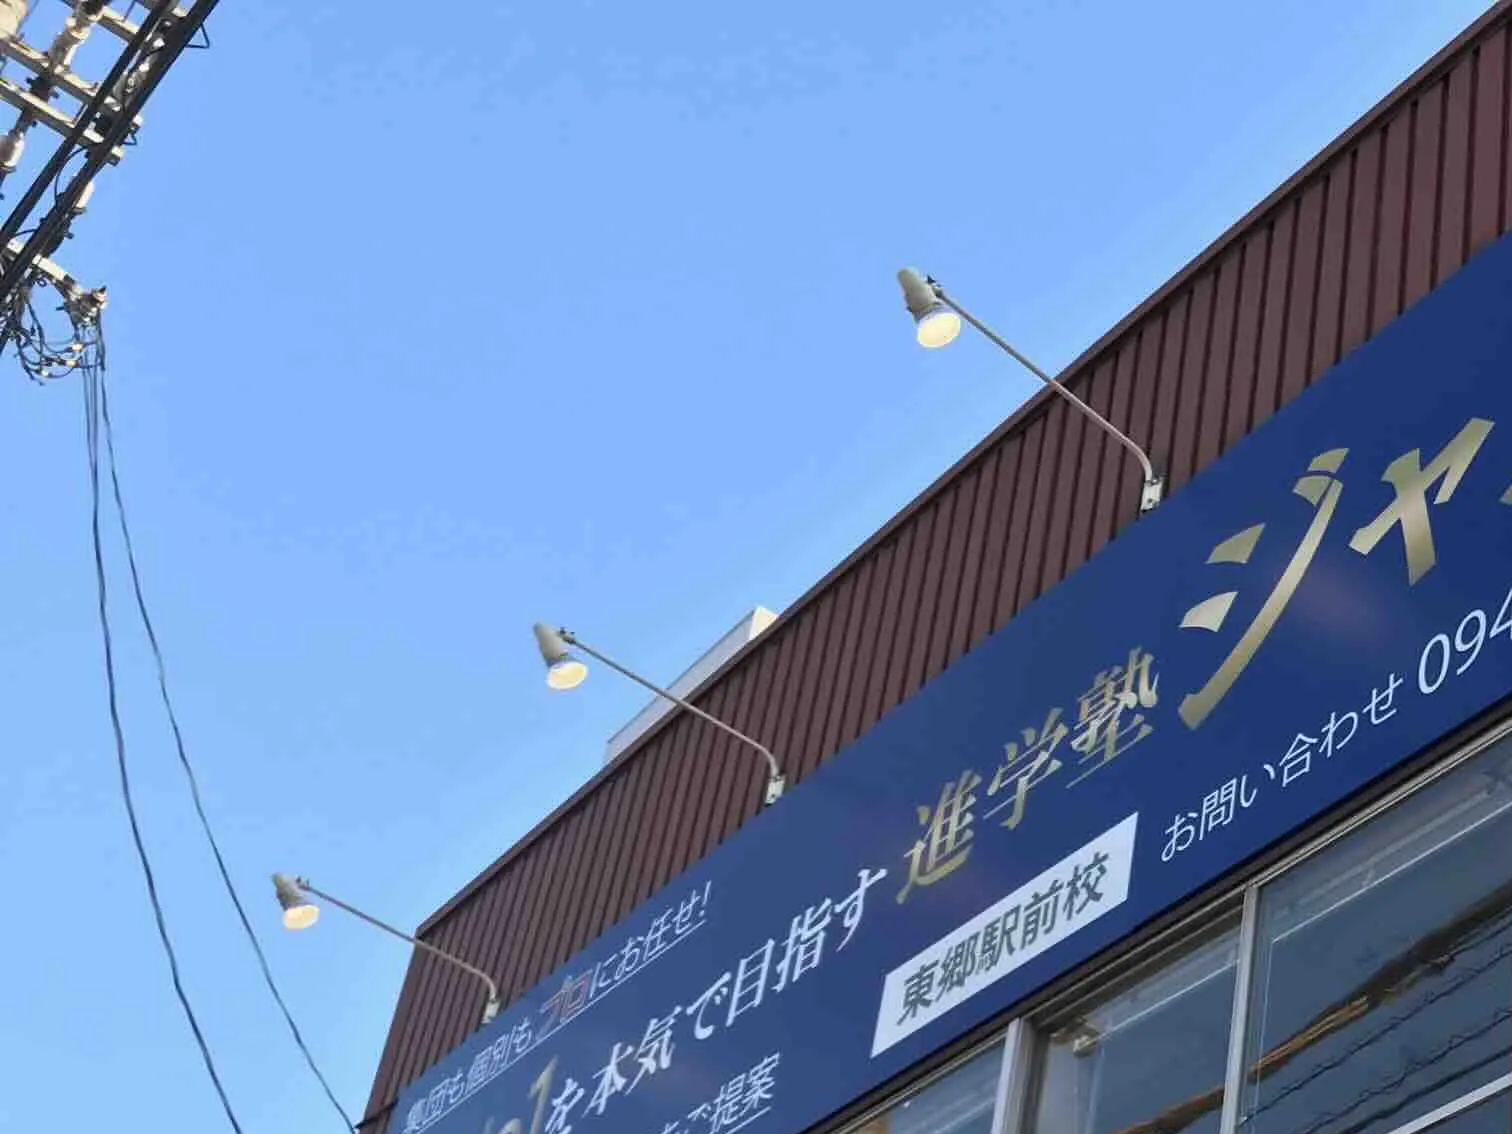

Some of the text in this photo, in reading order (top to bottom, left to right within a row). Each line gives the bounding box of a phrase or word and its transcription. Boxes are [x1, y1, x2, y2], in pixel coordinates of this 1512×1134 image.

[896, 647, 1160, 904] 進学塾
[1161, 673, 1404, 862] お問い合わせ
[895, 851, 1111, 1026] 東郷駅前校
